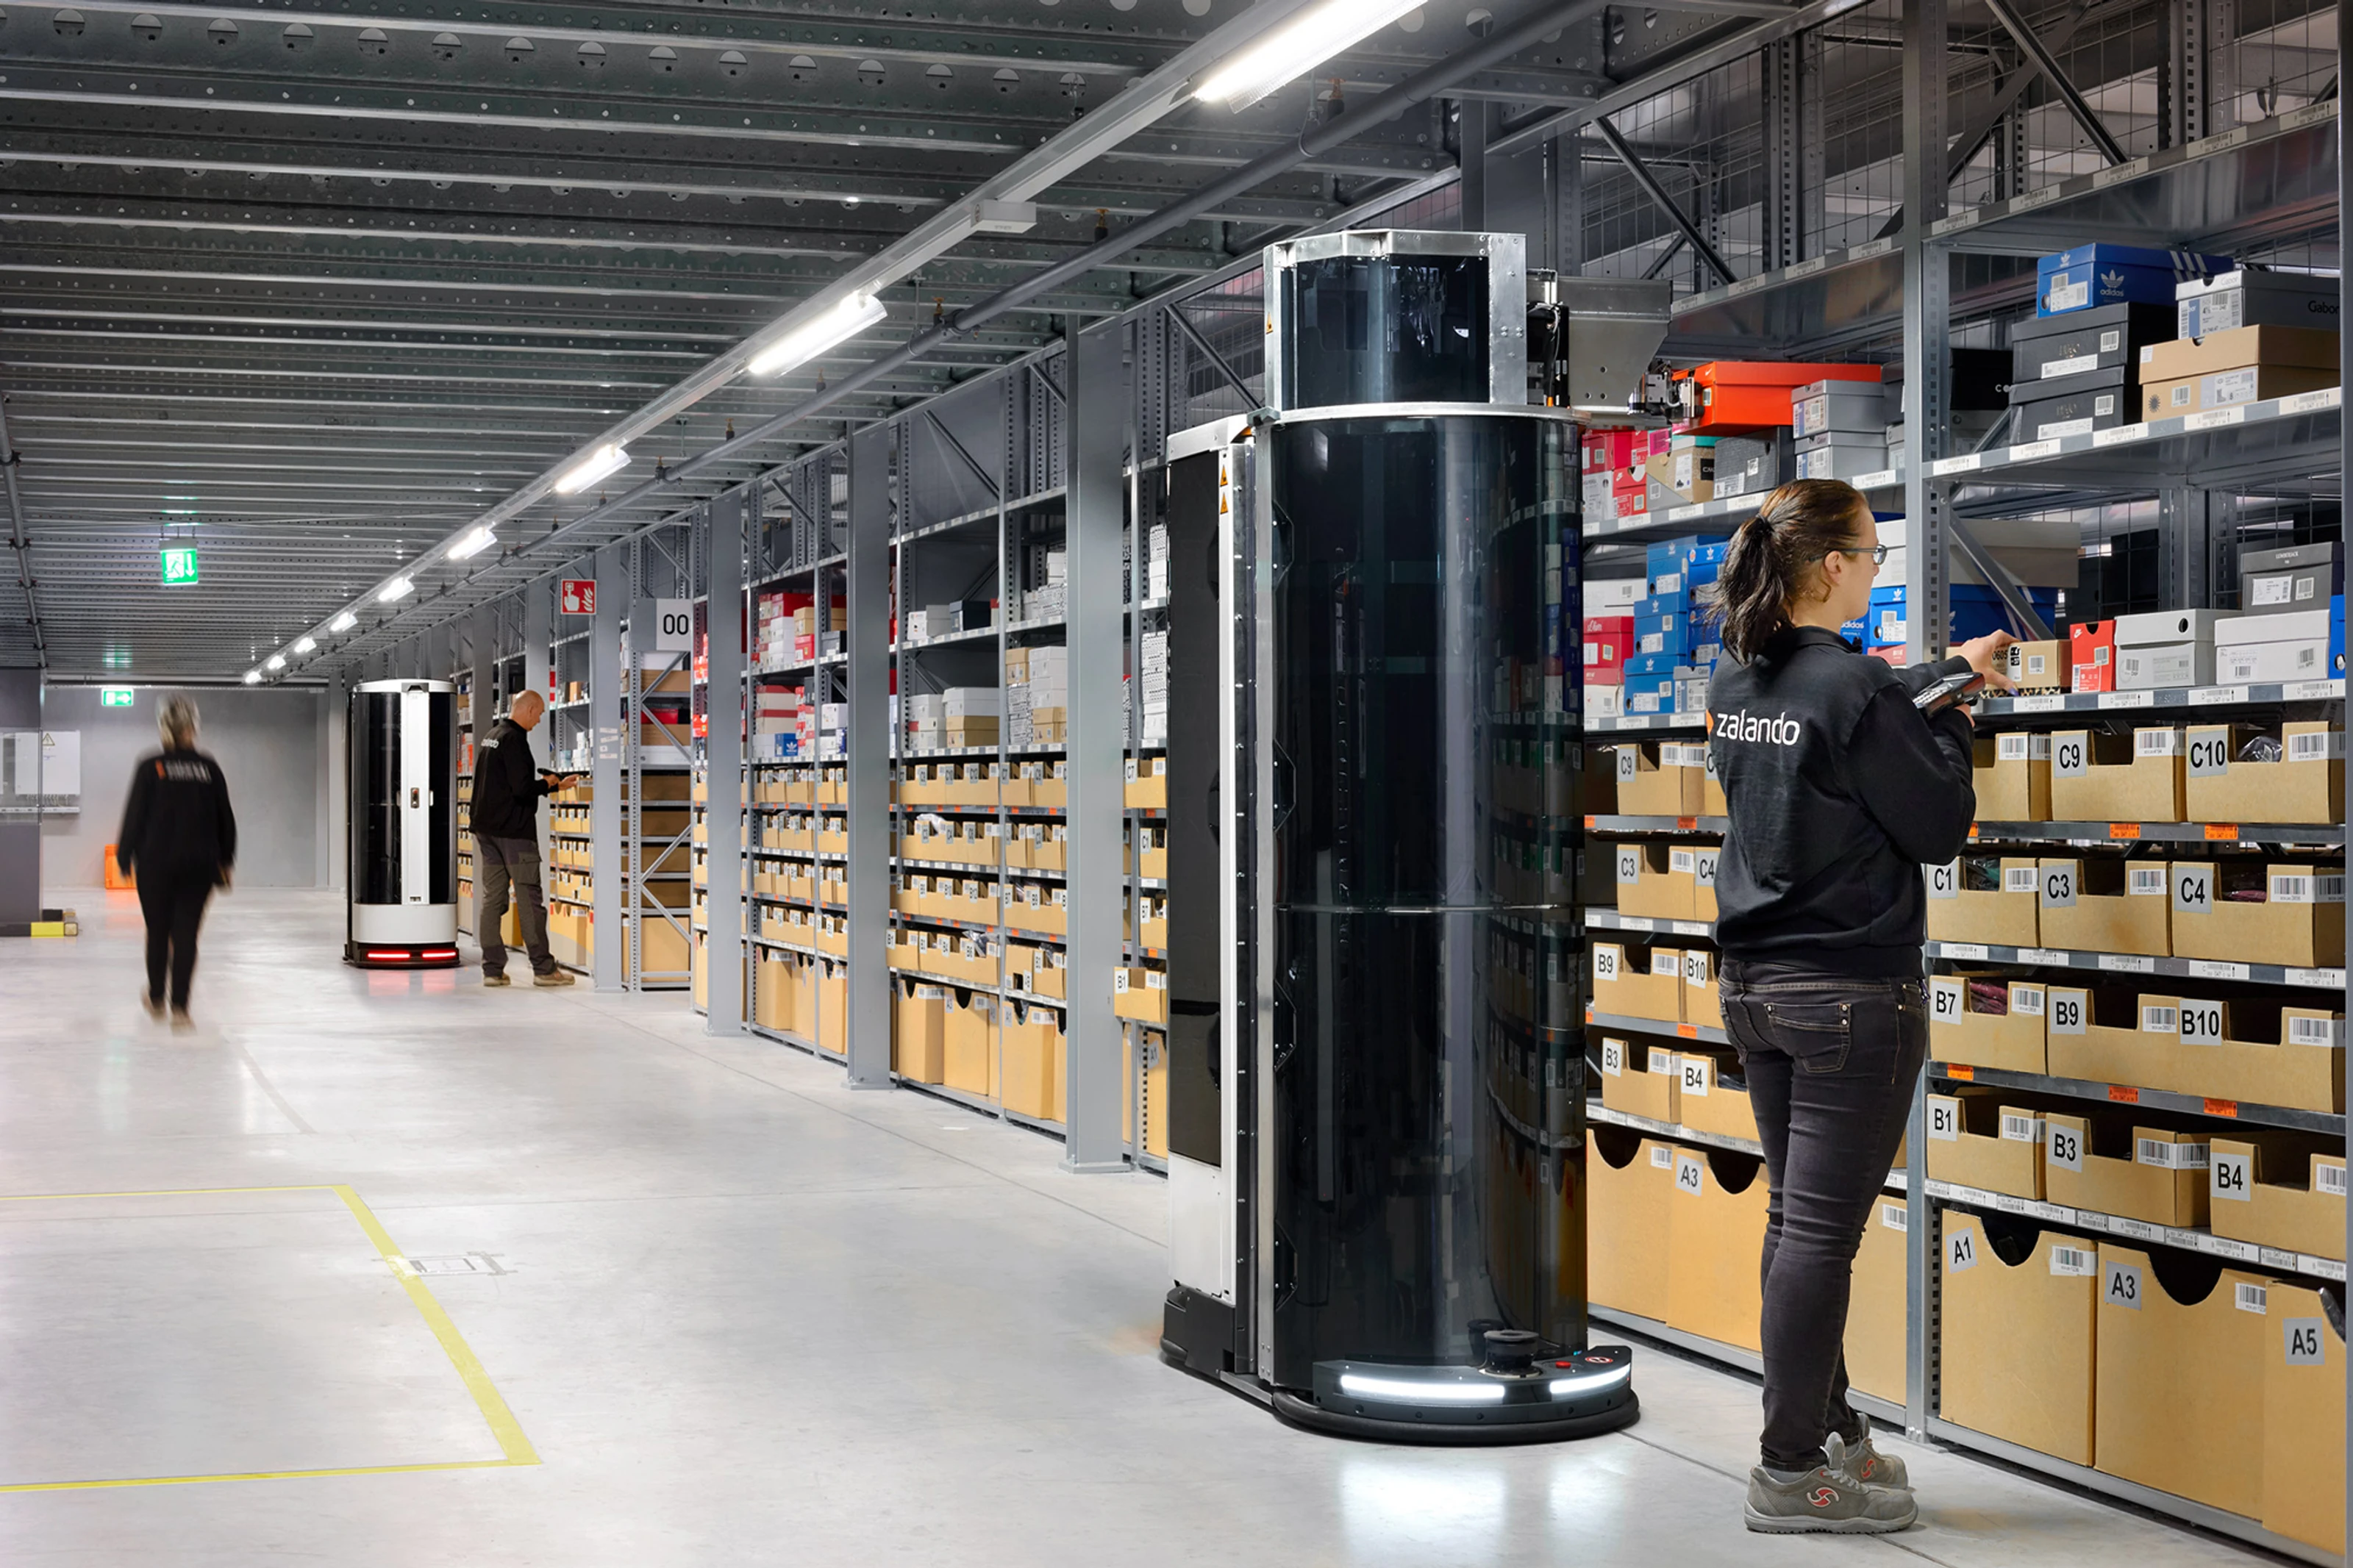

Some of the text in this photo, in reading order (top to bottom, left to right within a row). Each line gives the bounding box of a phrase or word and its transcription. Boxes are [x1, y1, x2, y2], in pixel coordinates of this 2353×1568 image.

[2221, 276, 2238, 285] Gabor
[2100, 289, 2124, 297] adidas
[2308, 300, 2340, 315] Gabor
[663, 614, 688, 635] 00
[1716, 709, 1801, 745] zalando
[1621, 756, 1632, 774] C9
[2060, 744, 2080, 769] C9
[2190, 740, 2226, 768] C10
[1621, 857, 1635, 877] C3
[1699, 859, 1715, 879] C4
[1935, 868, 1952, 891] C1
[2048, 874, 2069, 899] C3
[2181, 877, 2205, 904] C4
[1599, 954, 1613, 973] B9
[1688, 958, 1706, 981] B10
[1118, 975, 1126, 989] B1
[1936, 991, 1956, 1015] B7
[2057, 1001, 2078, 1025] B9
[2182, 1009, 2219, 1037] B10
[1606, 1048, 1618, 1069] B3
[1685, 1067, 1703, 1088] B4
[1935, 1109, 1952, 1131] B1
[2054, 1134, 2076, 1161] B3
[1680, 1164, 1698, 1188] A3
[2218, 1162, 2243, 1191] B4
[1954, 1236, 1971, 1264] A1
[2112, 1272, 2135, 1300] A3
[2292, 1328, 2317, 1356] A5
